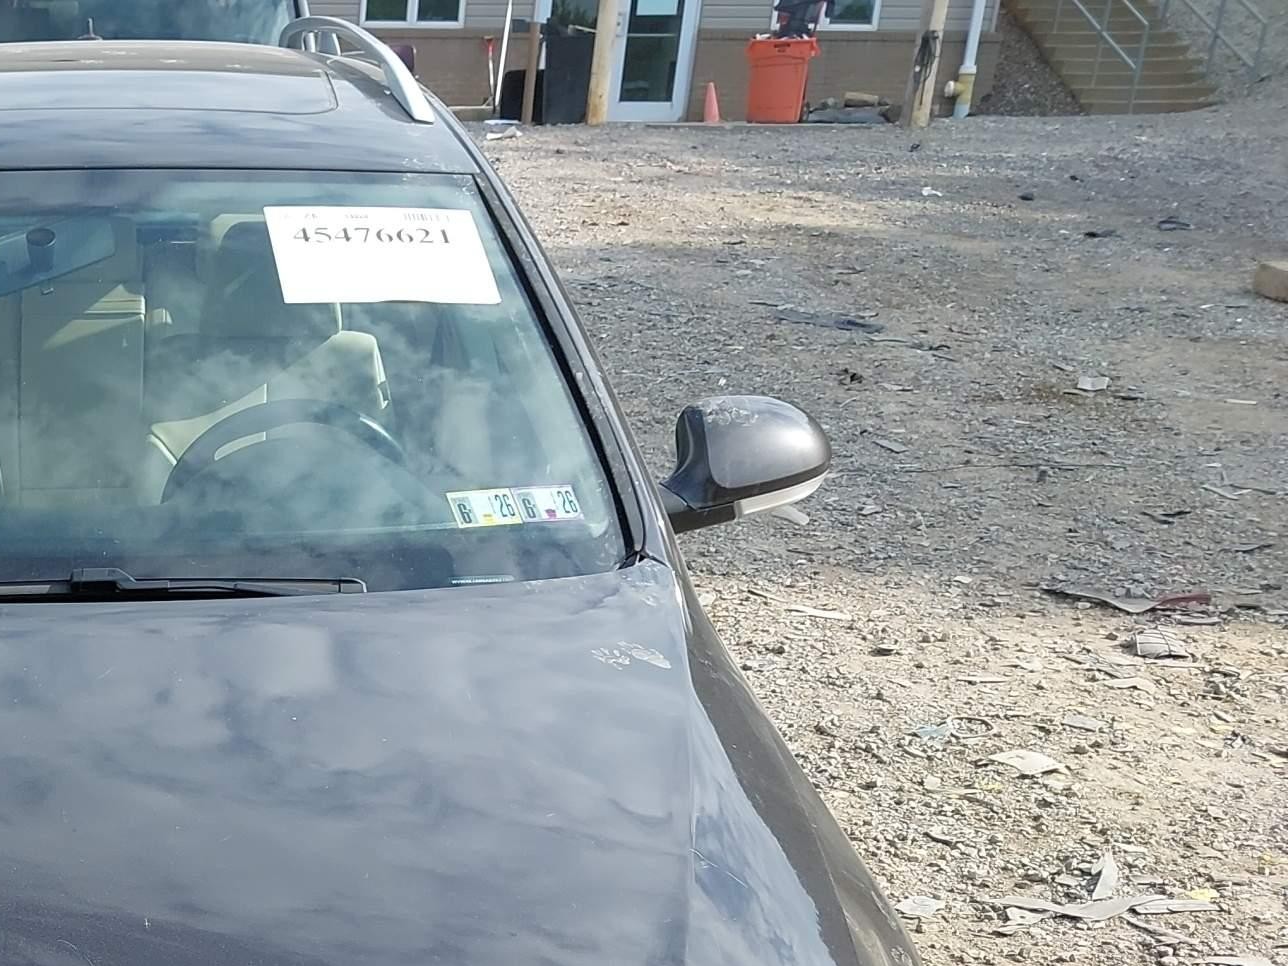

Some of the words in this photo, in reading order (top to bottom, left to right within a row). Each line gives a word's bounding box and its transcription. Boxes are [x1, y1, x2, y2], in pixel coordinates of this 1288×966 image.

[293, 227, 450, 243] 45476621
[494, 494, 516, 517] 26
[557, 490, 578, 513] 26
